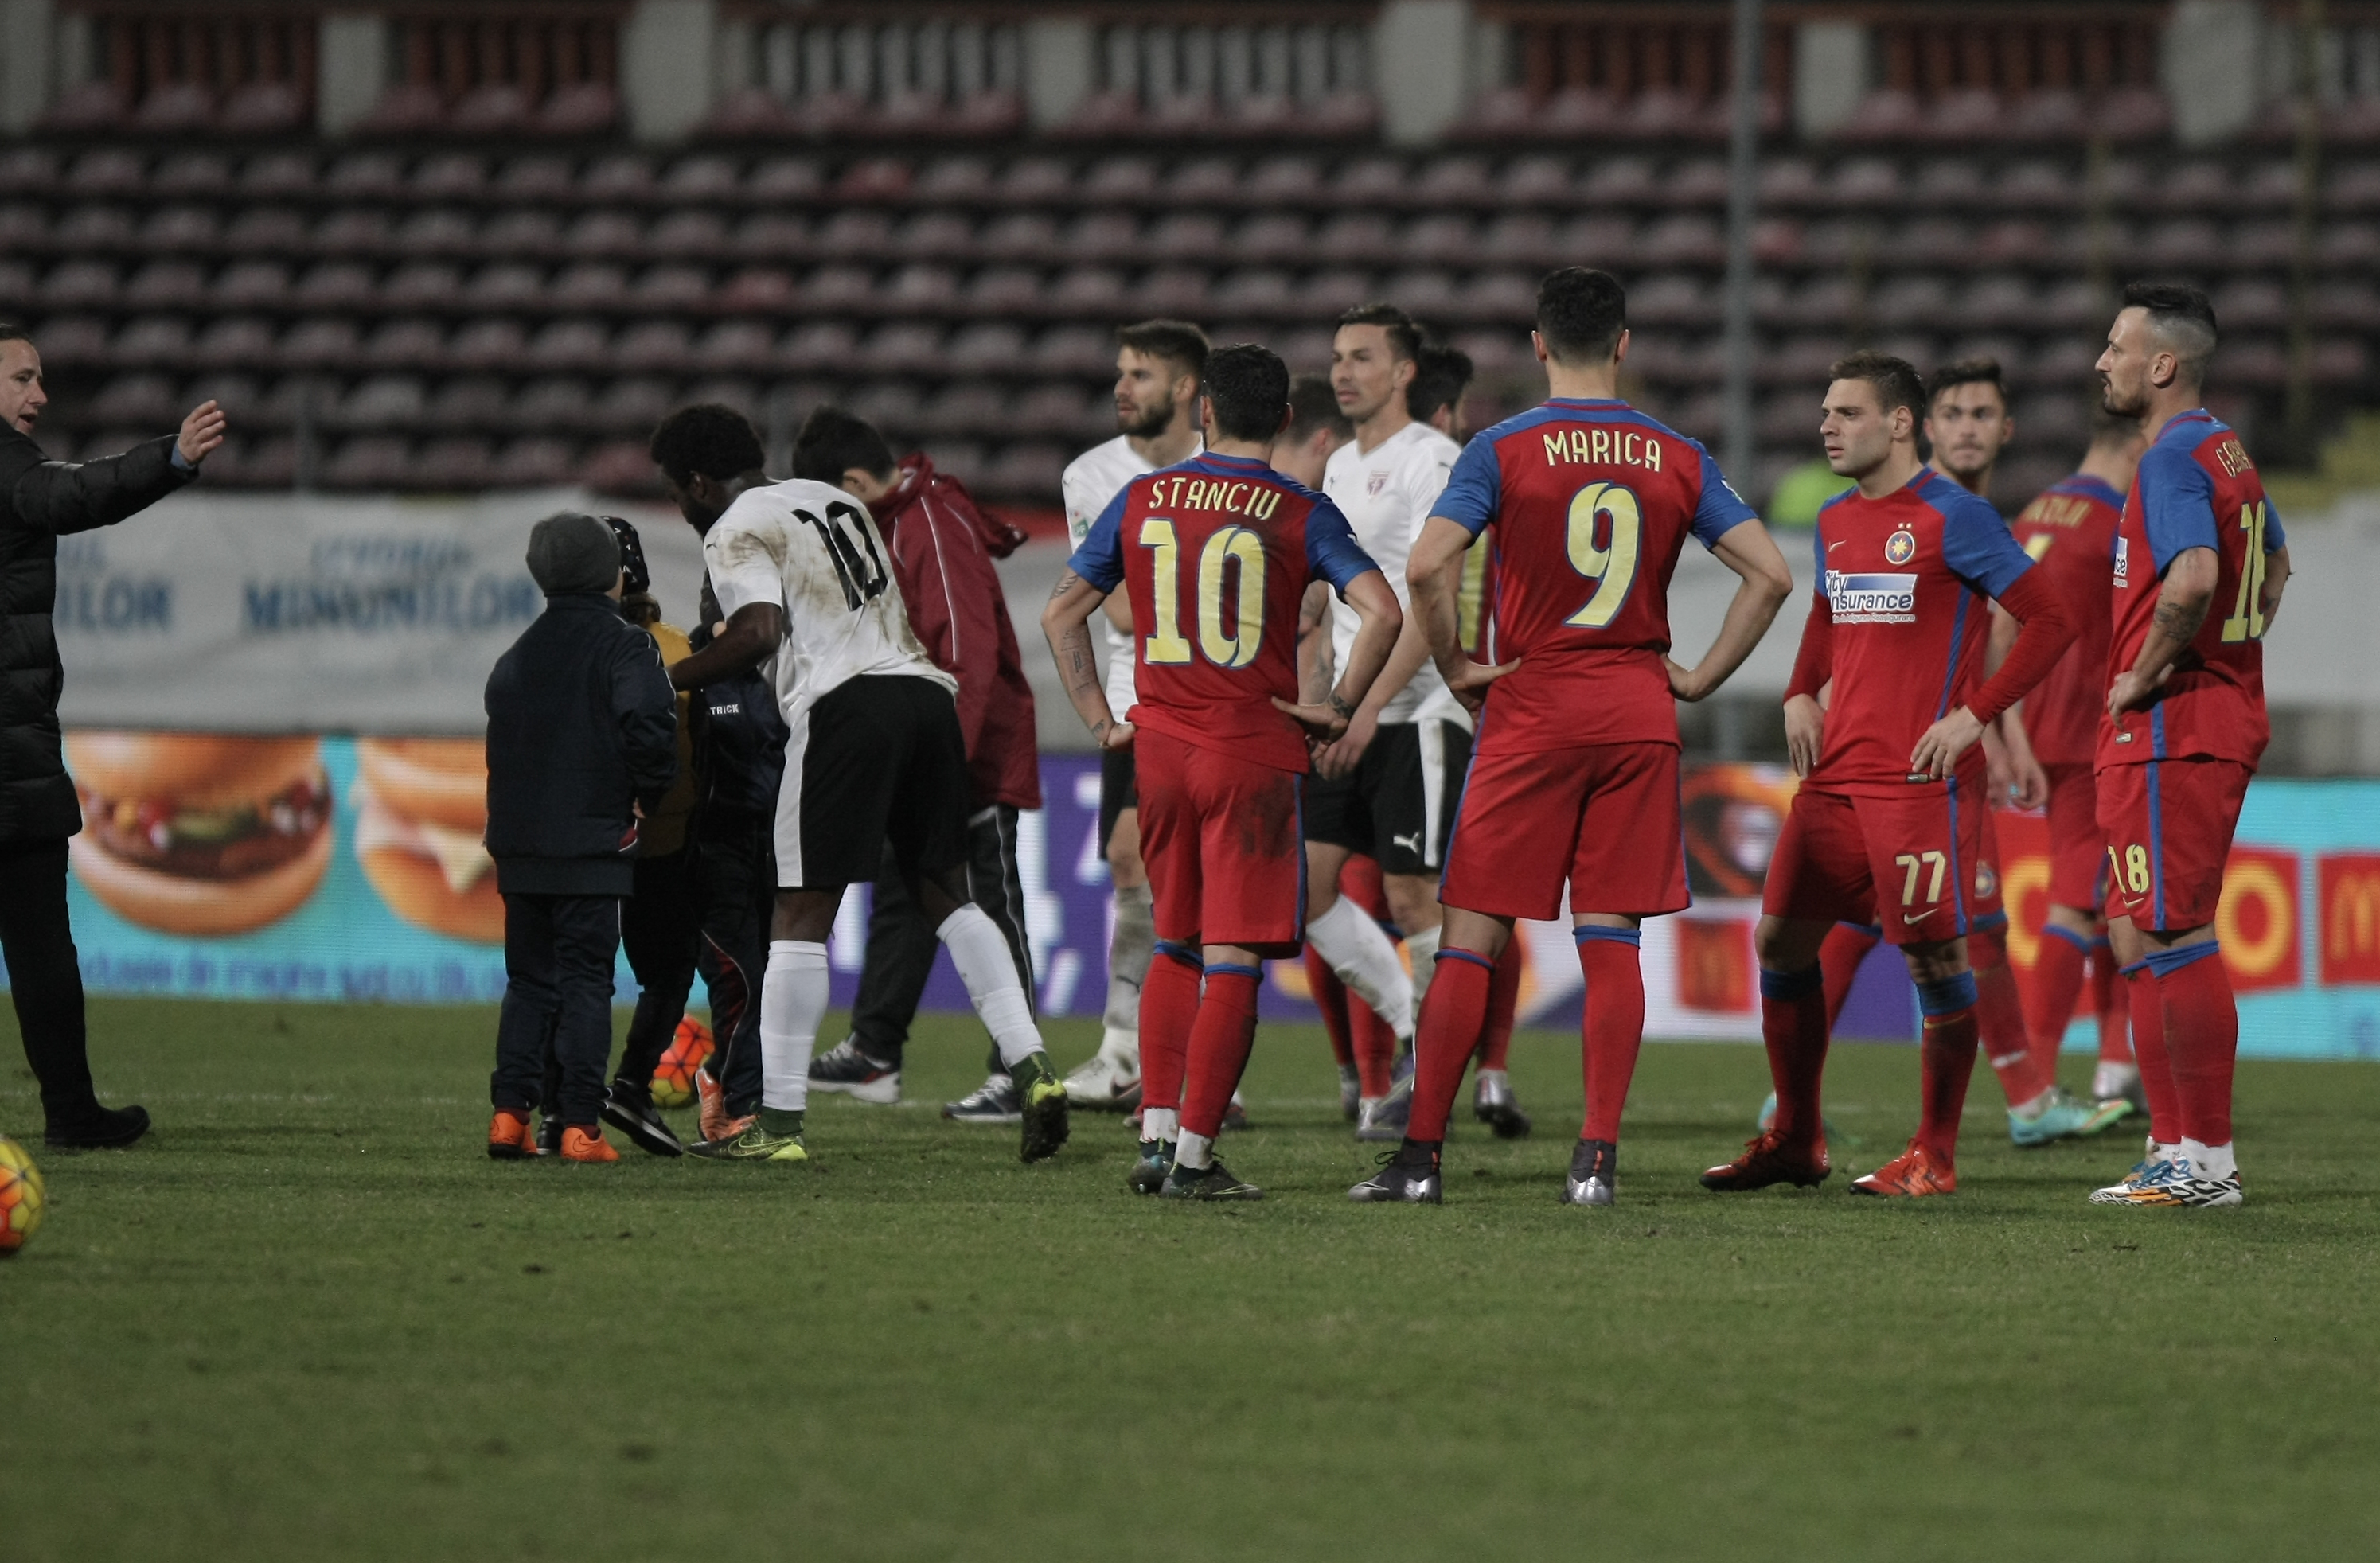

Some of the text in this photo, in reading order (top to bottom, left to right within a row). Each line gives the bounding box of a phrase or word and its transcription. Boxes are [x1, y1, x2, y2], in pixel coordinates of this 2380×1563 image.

[1543, 430, 1661, 472] MARICA
[1149, 477, 1281, 520] STANCIU
[791, 500, 888, 612] 10
[1563, 480, 1643, 629] 9
[1139, 517, 1266, 669] 10
[1830, 593, 1912, 610] nsurance
[709, 704, 739, 715] TRICK
[1895, 850, 1946, 906] 77
[2107, 844, 2149, 894] 18
